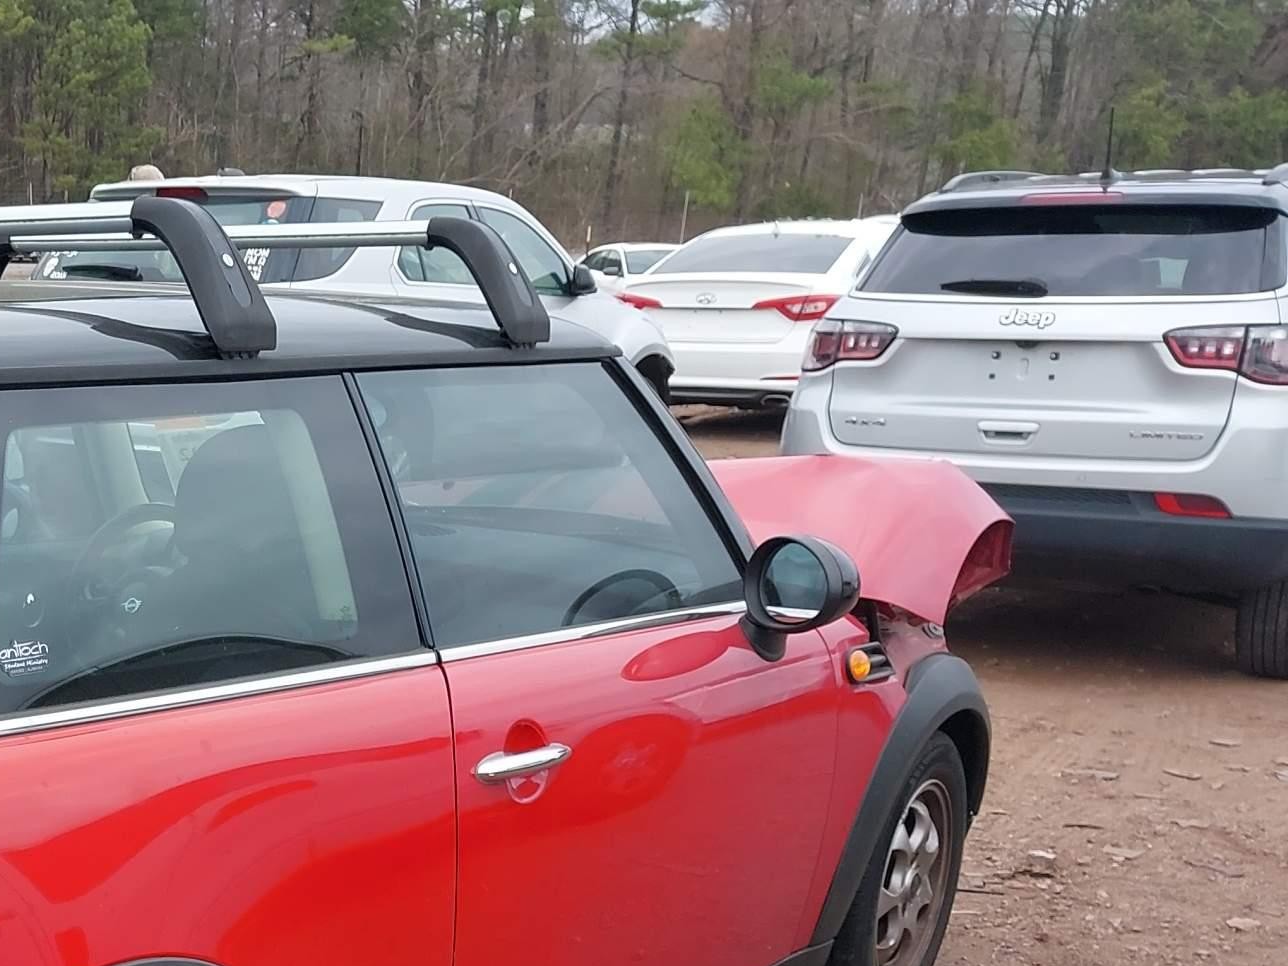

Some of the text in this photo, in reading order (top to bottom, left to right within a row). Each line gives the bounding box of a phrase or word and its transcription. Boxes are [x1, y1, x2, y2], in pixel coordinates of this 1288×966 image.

[999, 308, 1056, 329] Jeep
[1128, 430, 1205, 441] LIMITED
[4, 661, 26, 670] Student
[26, 658, 49, 668] Ministry
